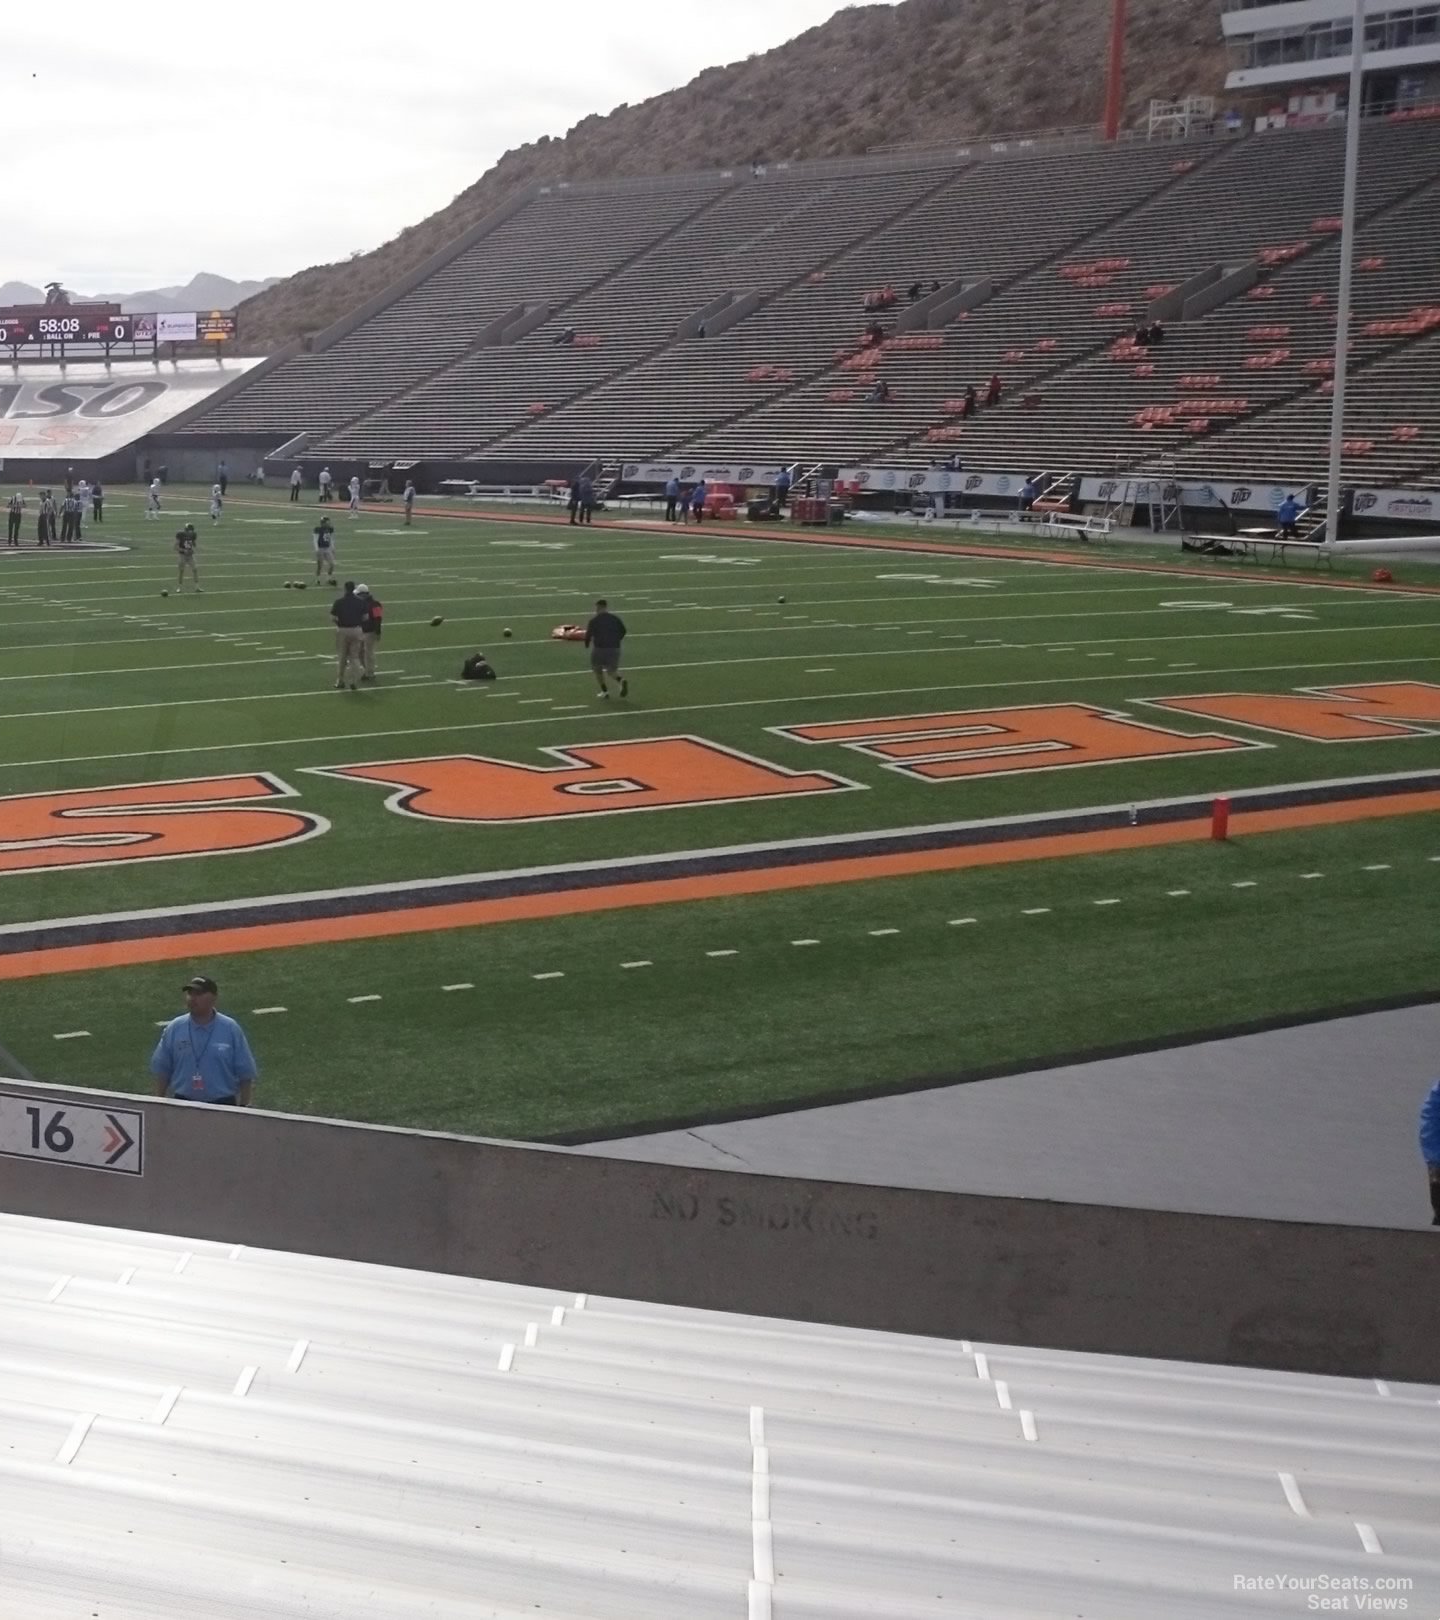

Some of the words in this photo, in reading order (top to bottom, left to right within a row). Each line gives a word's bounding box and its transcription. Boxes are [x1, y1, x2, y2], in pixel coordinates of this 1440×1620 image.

[39, 318, 80, 333] 58:08
[114, 325, 125, 339] 0
[25, 1106, 75, 1154] 16
[650, 1190, 700, 1221] NO
[717, 1197, 880, 1240] SMOKING
